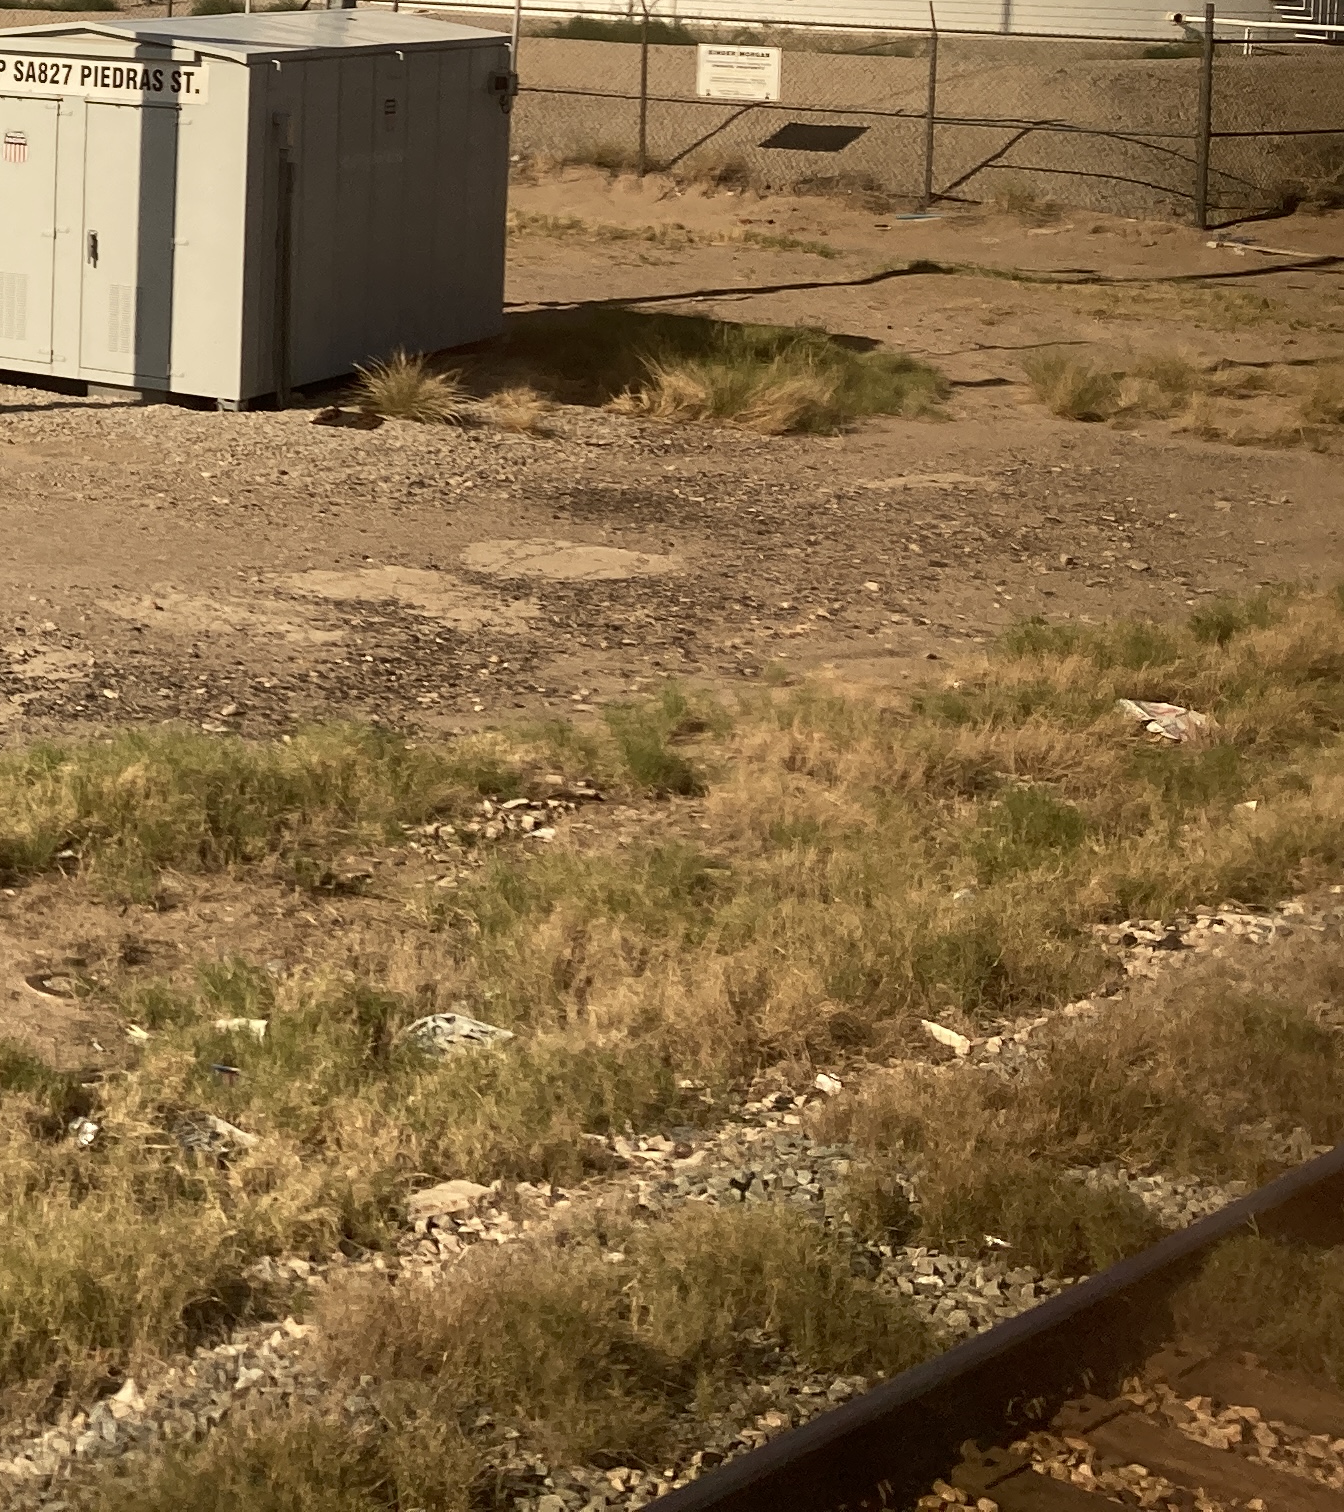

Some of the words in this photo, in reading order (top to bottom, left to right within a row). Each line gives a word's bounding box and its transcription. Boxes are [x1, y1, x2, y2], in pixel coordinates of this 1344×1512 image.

[13, 60, 73, 86] SA827
[80, 65, 164, 93] PIEDRAS
[170, 70, 200, 94] ST.
